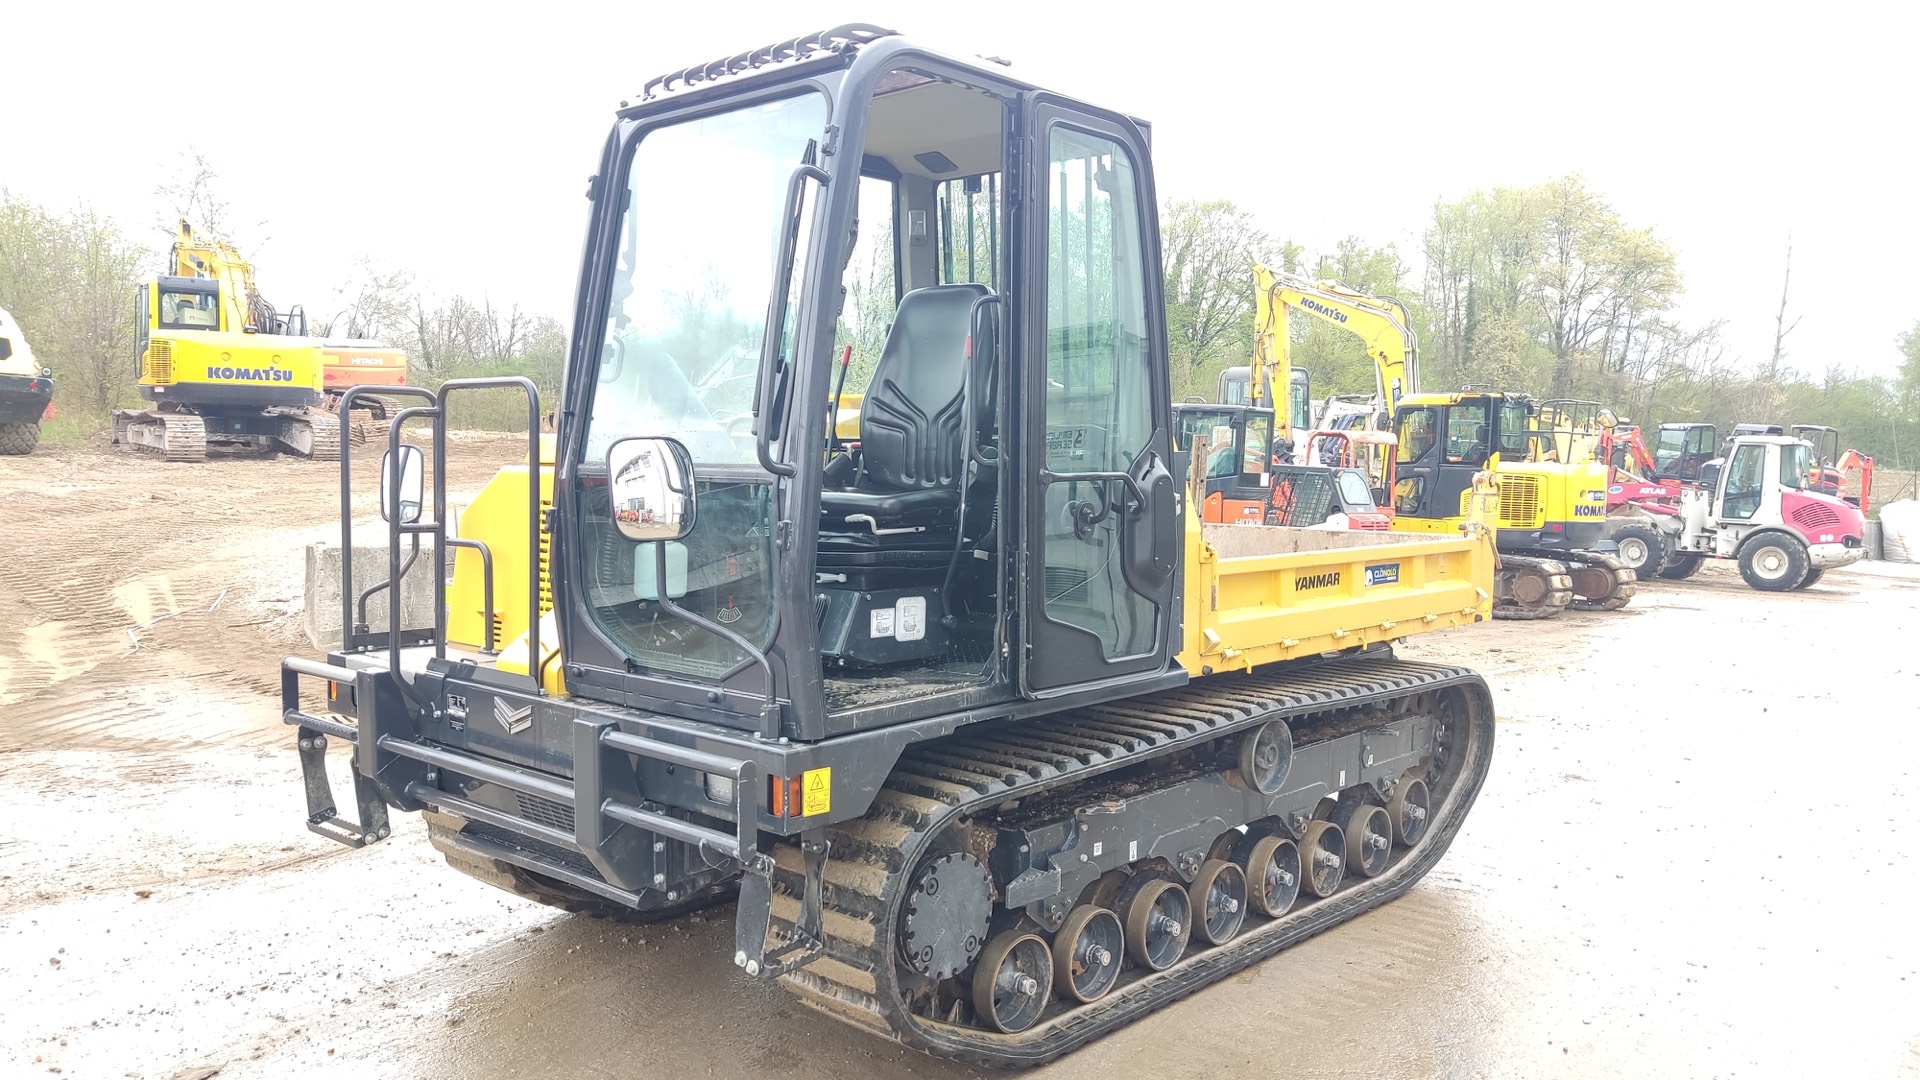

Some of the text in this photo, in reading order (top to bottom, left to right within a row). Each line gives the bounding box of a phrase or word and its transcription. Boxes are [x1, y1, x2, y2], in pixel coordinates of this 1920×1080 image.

[1300, 297, 1348, 323] KOMATSU
[351, 357, 383, 365] HITACHI
[207, 366, 293, 382] KOMATSU
[1295, 572, 1340, 591] YANMAR
